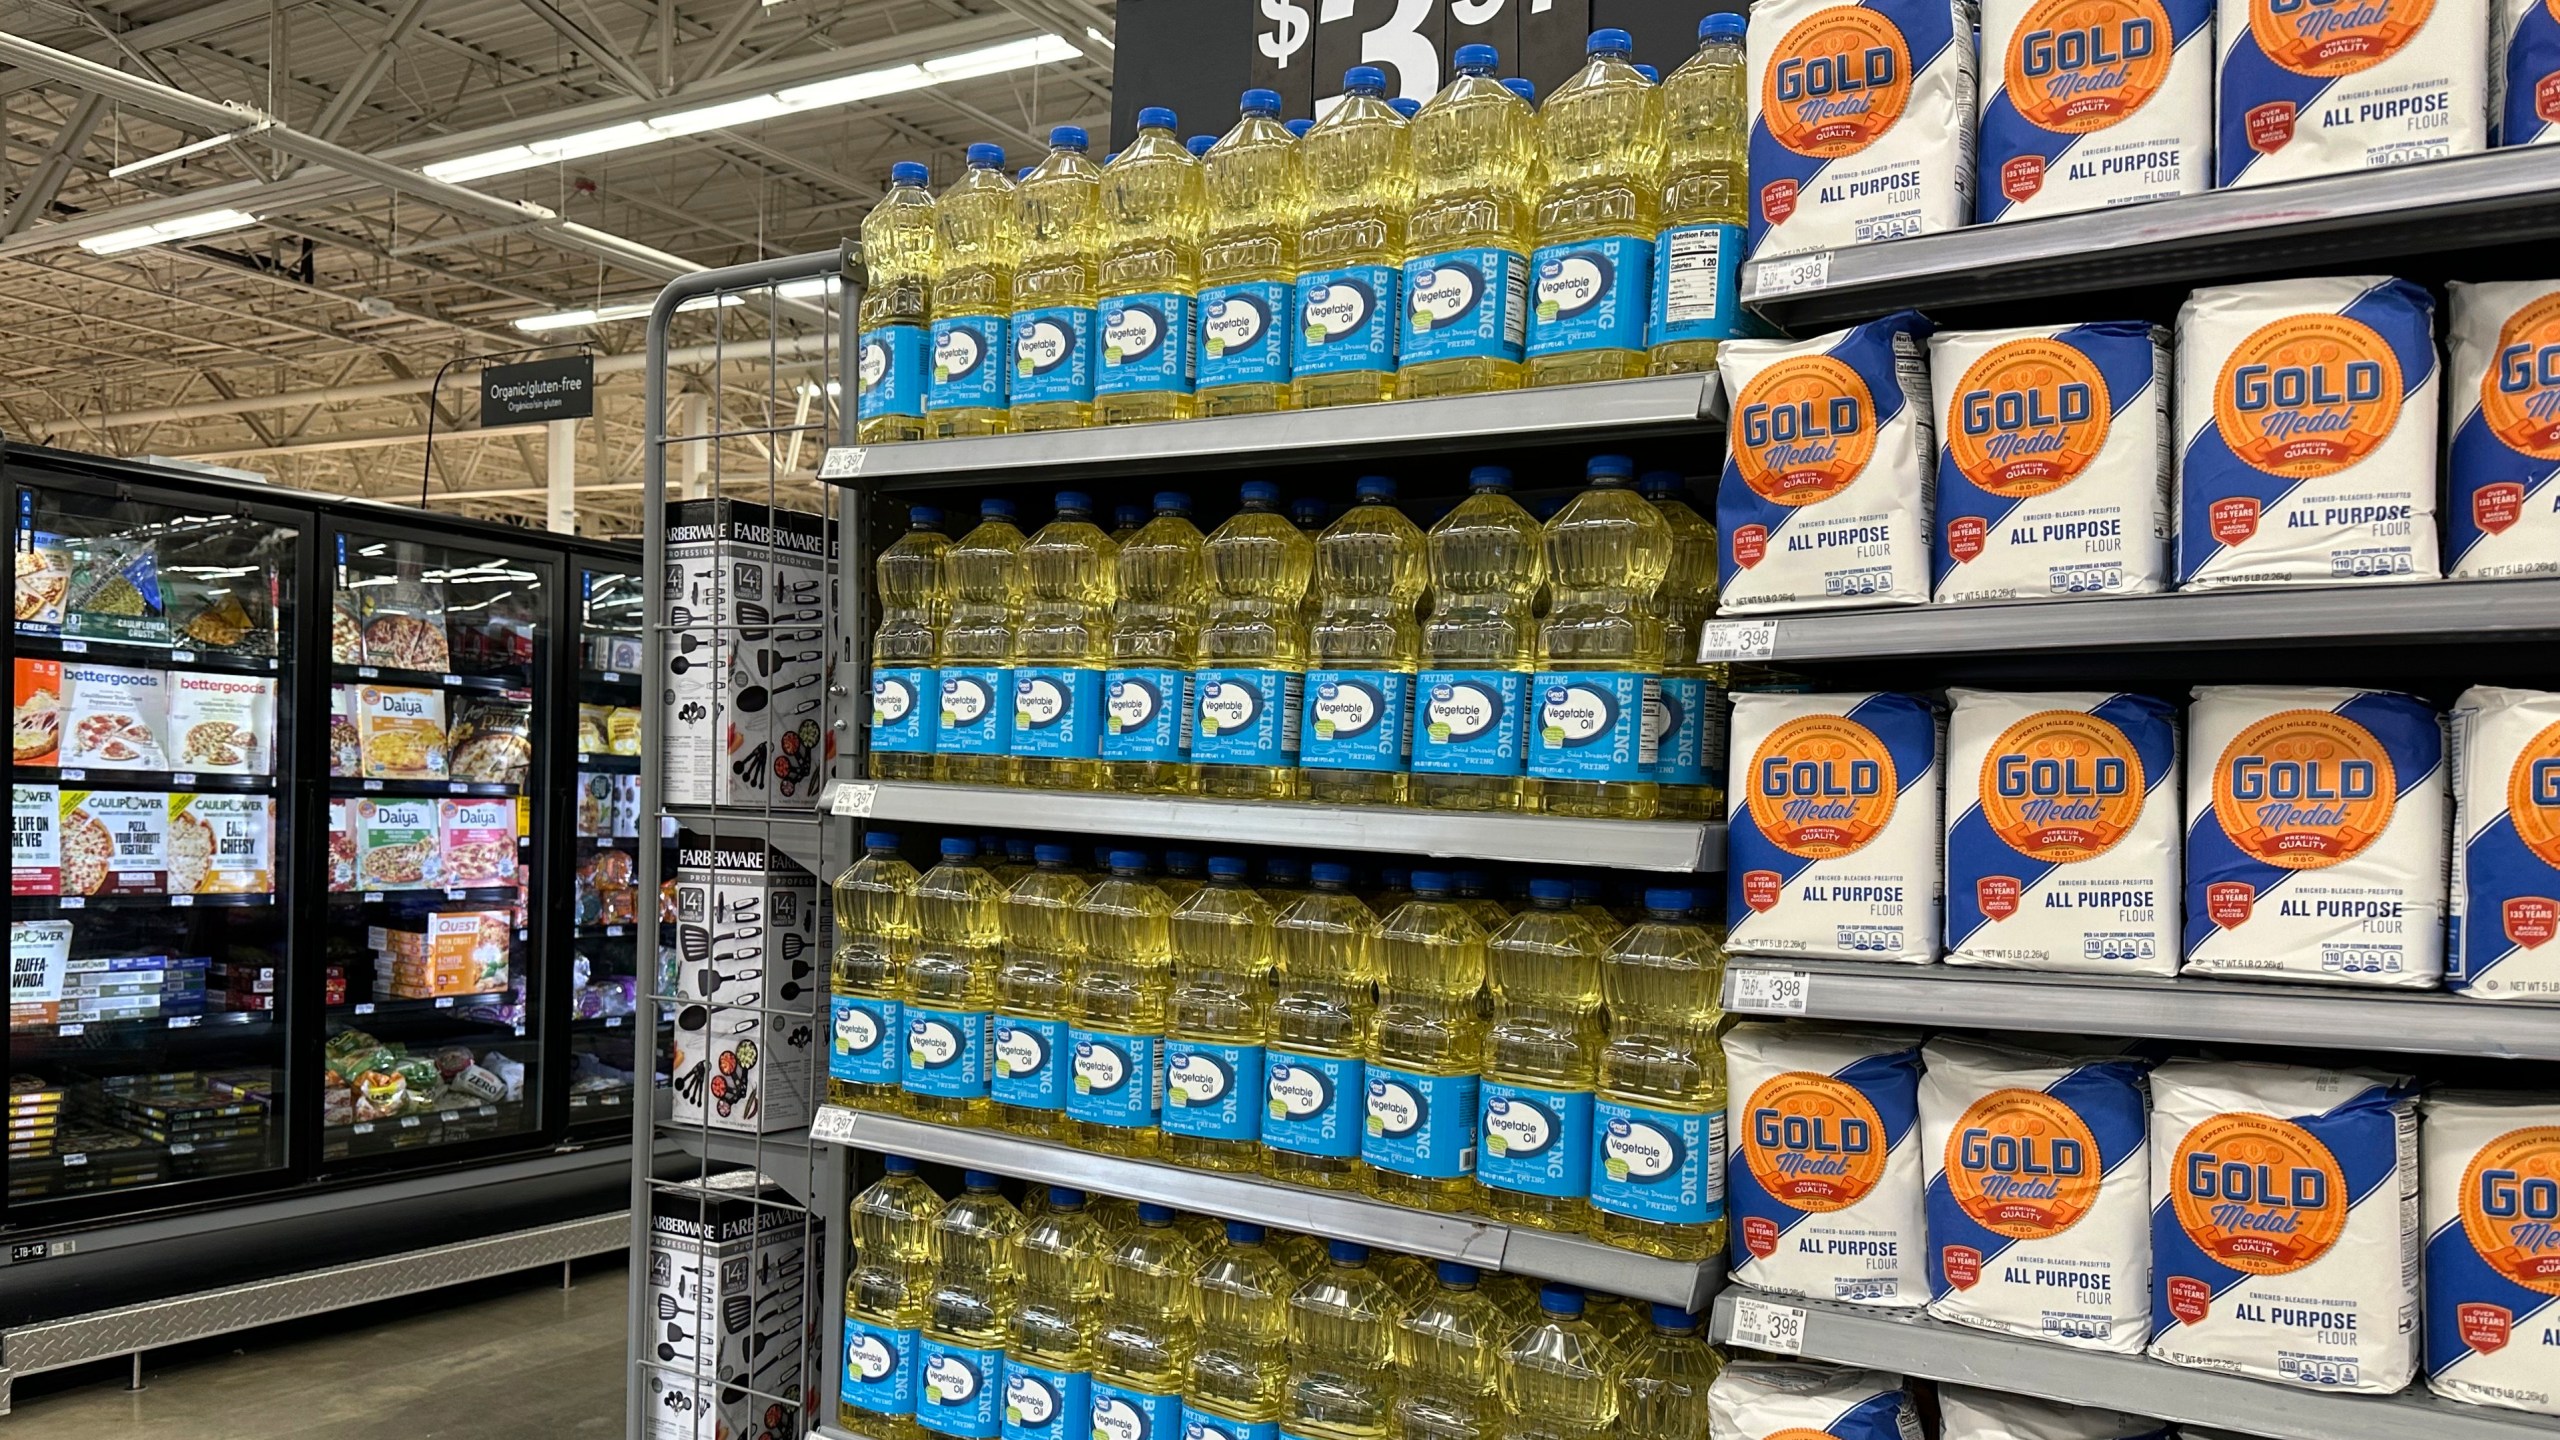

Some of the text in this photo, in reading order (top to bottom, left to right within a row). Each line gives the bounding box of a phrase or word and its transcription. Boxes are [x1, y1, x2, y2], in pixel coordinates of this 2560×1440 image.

[2023, 17, 2154, 78] GOLD
[1777, 47, 1894, 101] GOLD
[2047, 64, 2126, 100] Medal
[1797, 90, 1871, 123] Medal
[2069, 151, 2180, 181] ALL PURPOSE
[2144, 167, 2180, 184] FLOUR
[1821, 171, 1920, 203] ALL PURPOSE
[1888, 188, 1920, 204] FLOUR
[1672, 230, 1718, 240] Nutrition Facts
[1671, 258, 1717, 270] Calories 120
[1297, 274, 1329, 288] FRYING
[1541, 276, 1590, 293] Vegetable
[1417, 286, 1461, 305] Vegetable
[1478, 252, 1498, 340] BAKING
[1575, 287, 1589, 298] Oil
[1310, 303, 1354, 317] Vegetable
[1448, 298, 1461, 308] Oil
[1341, 312, 1353, 323] Oil
[1370, 270, 1388, 354] BAKING
[1210, 317, 1250, 331] Vegetable
[1020, 339, 1056, 352] Vegetable
[1162, 298, 1179, 376] BAKING
[1072, 311, 1087, 387] BAKING
[491, 376, 582, 401] Organic/gluten-free
[2234, 360, 2381, 411] GOLD
[1963, 382, 2092, 437] GOLD
[2261, 406, 2352, 441] Medal
[1986, 427, 2066, 461] Medal
[2288, 505, 2411, 536] ALL PURPOSE
[734, 522, 823, 552] FARBERWARE
[2011, 520, 2120, 546] ALL PURPOSE
[2373, 521, 2411, 538] FLOUR
[2085, 538, 2121, 553] FLOUR
[747, 551, 812, 567] PROFSSIONAL
[64, 669, 158, 687] bettergoods
[180, 678, 266, 695] bettergoods
[1534, 676, 1568, 685] FRYING
[383, 696, 423, 716] Daiya
[1206, 701, 1242, 711] Vegetable
[1258, 675, 1276, 750] BAKING
[1434, 705, 1480, 717] Vegetable
[1548, 708, 1594, 720] Vegetable
[1466, 715, 1479, 725] Oil
[1498, 676, 1517, 758] BAKING
[1580, 719, 1593, 729] Oil
[1613, 677, 1633, 764] BAKING
[2247, 724, 2285, 747] EXPERTLY
[2332, 725, 2346, 736] THE
[2347, 733, 2361, 746] USA
[1579, 763, 1609, 771] FRYING
[1998, 754, 2127, 797] GOLD
[1762, 756, 1880, 797] GOLD
[2232, 756, 2375, 800] GOLD
[379, 808, 419, 827] Daiya
[460, 808, 496, 827] Daiya
[1783, 798, 1856, 822] Medal
[2020, 798, 2100, 824] Medal
[2256, 803, 2349, 832] Medal
[18, 817, 48, 831] LIFE ON
[26, 833, 42, 847] VEG
[115, 832, 160, 844] YOUR FAVORITE
[221, 838, 255, 855] CHEESY
[2279, 841, 2327, 850] QUALITY
[679, 849, 764, 869] FARBERWARE
[690, 875, 752, 884] PROFSSIONAL
[680, 890, 698, 909] 14
[1803, 886, 1903, 903] ALL PURPOSE
[2045, 891, 2154, 908] ALL PURPOSE
[2225, 894, 2248, 902] YEARS
[1870, 903, 1904, 917] FLOUR
[2119, 908, 2154, 922] FLOUR
[2280, 901, 2402, 918] ALL PURPOSE
[439, 920, 477, 932] QUEST
[2363, 921, 2402, 934] FLOUR
[15, 957, 49, 973] BUFFA-
[2226, 960, 2237, 968] WT
[12, 972, 44, 987] WHOA
[913, 1037, 947, 1048] Vegetable
[962, 1016, 976, 1084] BAKING
[468, 1075, 497, 1094] ZERO
[1173, 1071, 1213, 1083] Vegetable
[1596, 1103, 1631, 1118] FRYING
[1611, 1139, 1660, 1157] Vegetable
[1961, 1128, 2083, 1176] GOLD
[1646, 1157, 1660, 1168] Oil
[1680, 1120, 1699, 1206] BAKING
[1981, 1173, 2058, 1202] Medal
[2187, 1151, 2327, 1210] GOLD
[1646, 1201, 1677, 1212] FRYING
[2211, 1203, 2296, 1235] Medal
[2005, 1267, 2111, 1290] ALL PURPOSE
[2077, 1289, 2111, 1305] FLOUR
[2236, 1303, 2358, 1330] ALL PURPOSE
[2317, 1329, 2358, 1346] FLOUR
[852, 1348, 882, 1363] Vegetable
[895, 1333, 910, 1400] BAKING
[930, 1369, 964, 1386] Vegetable
[978, 1354, 994, 1424] BAKING
